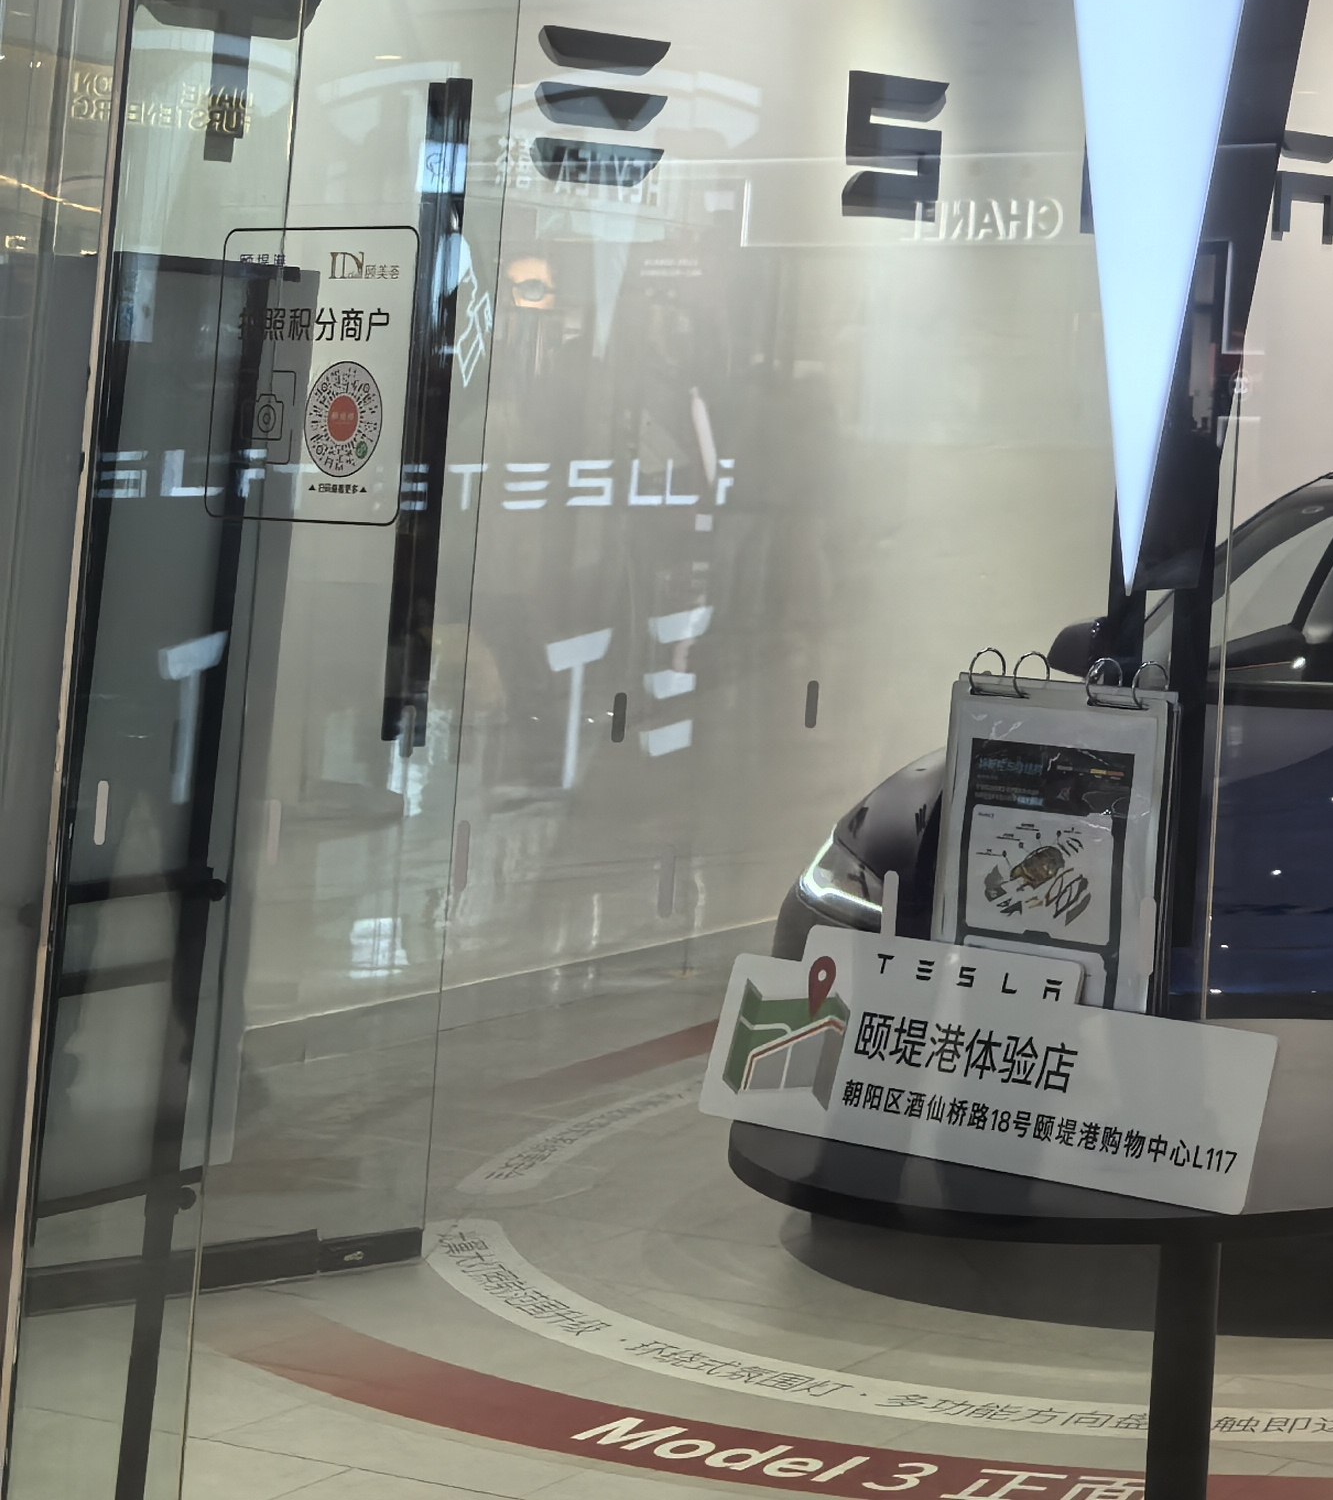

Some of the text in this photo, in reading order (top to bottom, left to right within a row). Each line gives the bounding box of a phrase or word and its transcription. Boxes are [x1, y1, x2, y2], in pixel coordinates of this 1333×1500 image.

[239, 307, 390, 342] 照积分商户
[877, 953, 1064, 1003] TESLA
[853, 1011, 1079, 1094] 颐堤港体验店
[842, 1079, 1239, 1177] 朝阳区酒仙桥路18号颐堤港购物中心L117
[571, 1414, 873, 1486] Model
[863, 1461, 940, 1493] 3
